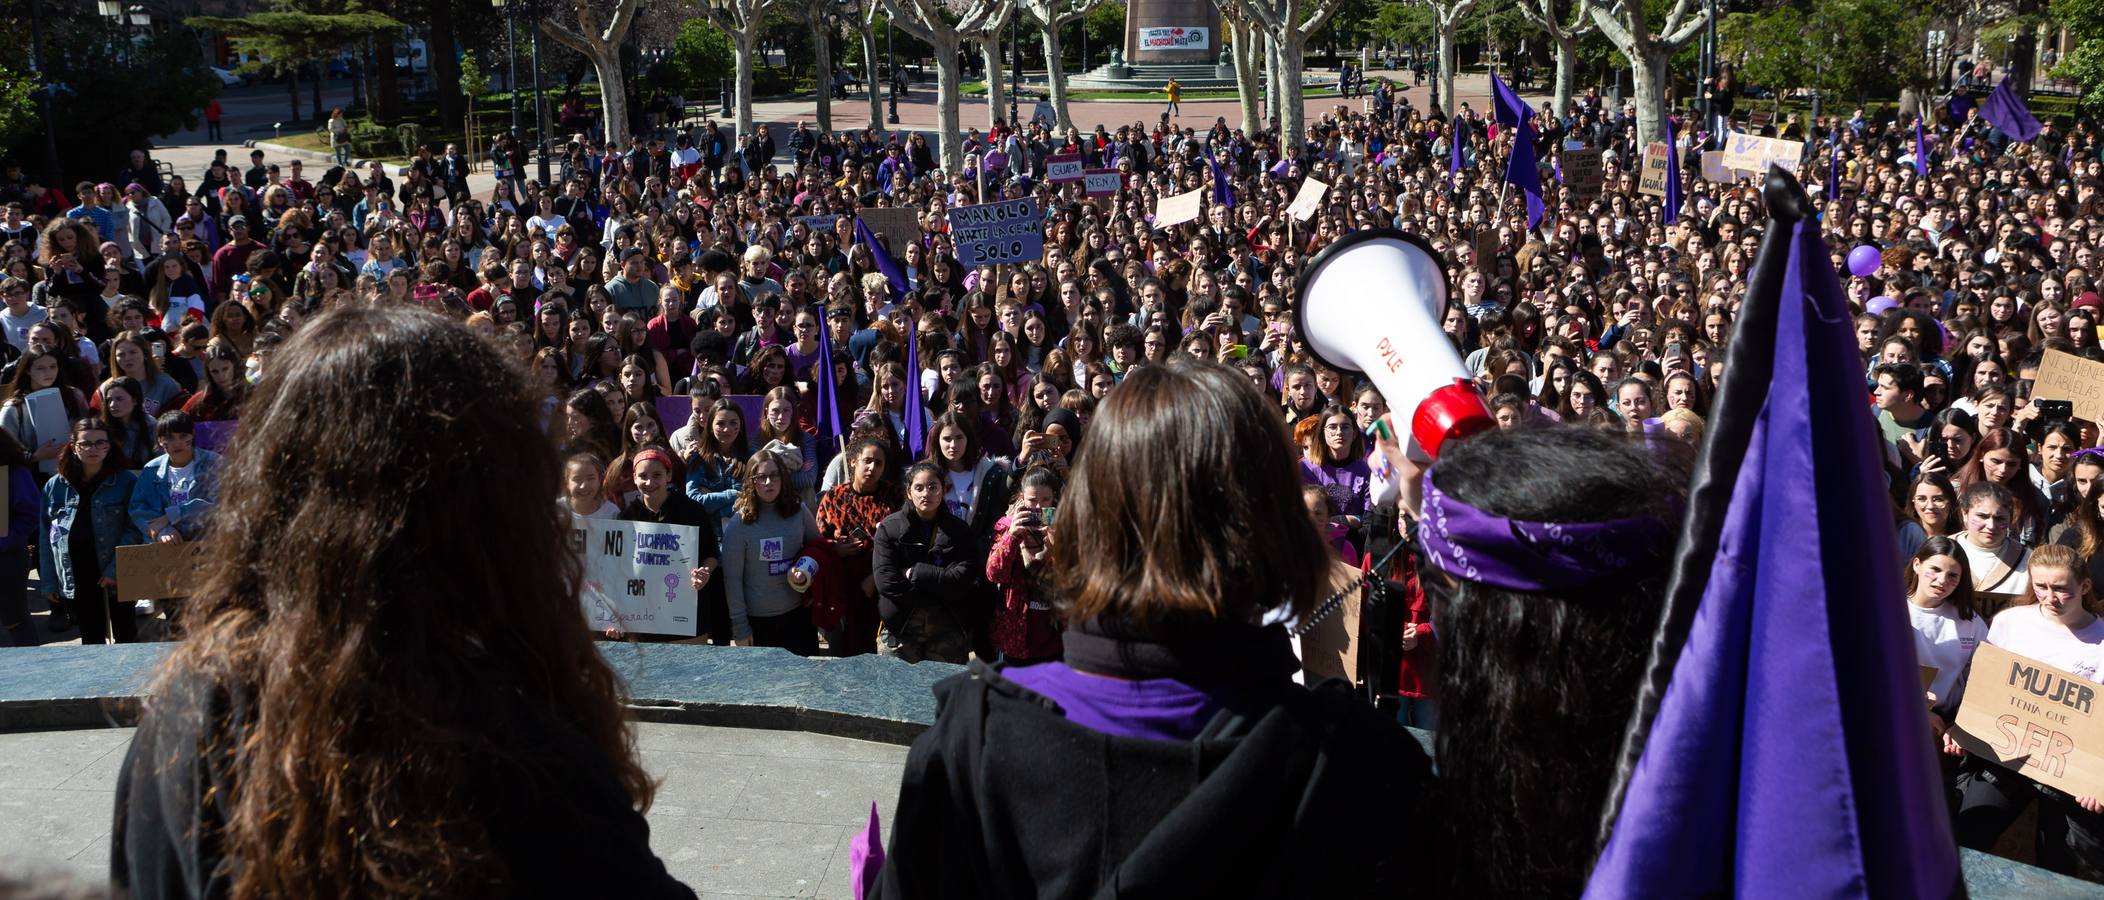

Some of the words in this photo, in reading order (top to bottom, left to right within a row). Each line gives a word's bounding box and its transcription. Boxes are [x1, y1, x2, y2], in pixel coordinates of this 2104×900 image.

[1174, 37, 1188, 45] MATA
[1052, 163, 1079, 175] GUAPA
[1088, 177, 1117, 188] NENA
[1642, 177, 1668, 192] IGUAL
[957, 202, 1030, 225] MANOLO
[956, 227, 989, 245] HAZTE
[992, 225, 1007, 238] LA
[1008, 220, 1039, 235] CENA
[974, 241, 1023, 263] SOLO
[1376, 336, 1403, 373] PYLE
[604, 530, 623, 557] NO
[636, 551, 671, 566] JUNTAS
[627, 579, 645, 596] POR
[2008, 660, 2095, 715] MUJER
[2010, 696, 2042, 717] TENÍA
[2046, 710, 2070, 726] QUE
[1991, 714, 2075, 779] SER
